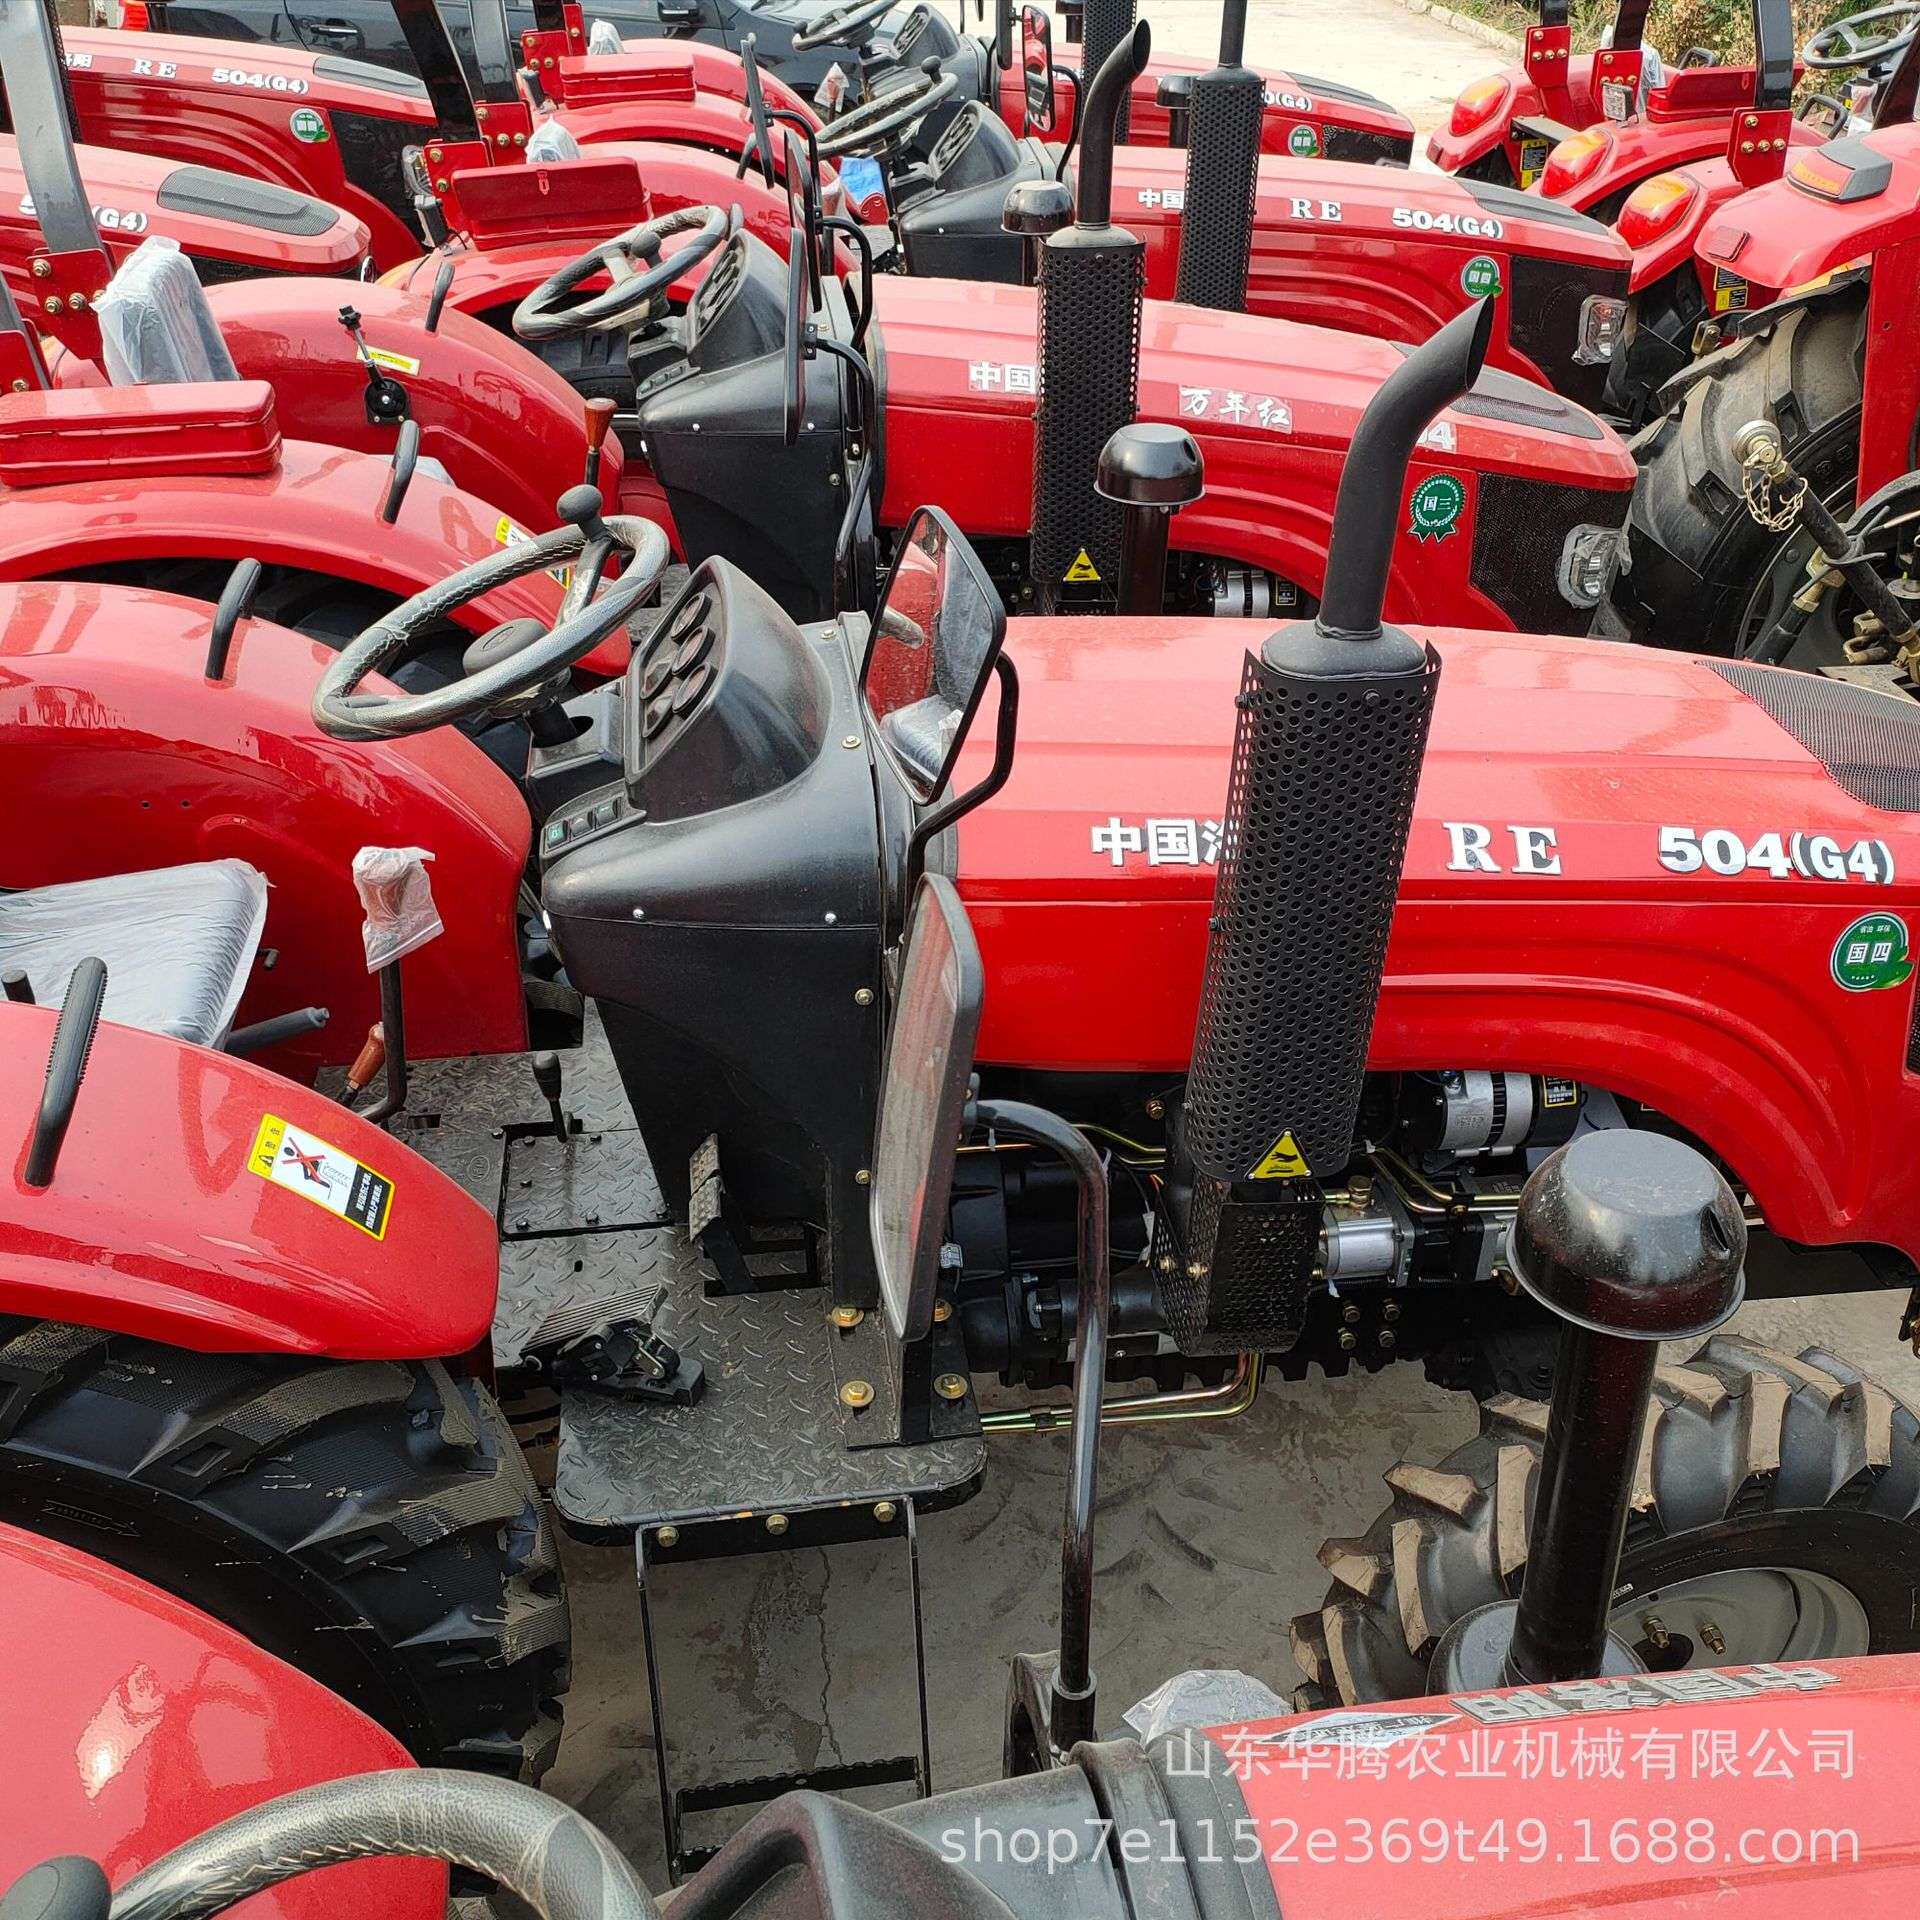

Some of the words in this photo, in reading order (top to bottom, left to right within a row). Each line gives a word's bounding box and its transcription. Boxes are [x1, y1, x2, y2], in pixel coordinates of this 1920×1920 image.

[1392, 207, 1503, 239] 504(G4)
[969, 361, 1036, 394] 中国
[1180, 387, 1291, 427] 万年红
[1423, 495, 1452, 512] 国三
[1442, 821, 1562, 875] RE
[1657, 825, 1896, 886] 504(G4)
[1847, 943, 1892, 964] 国四
[1450, 1664, 1840, 1724] 中国洛阳
